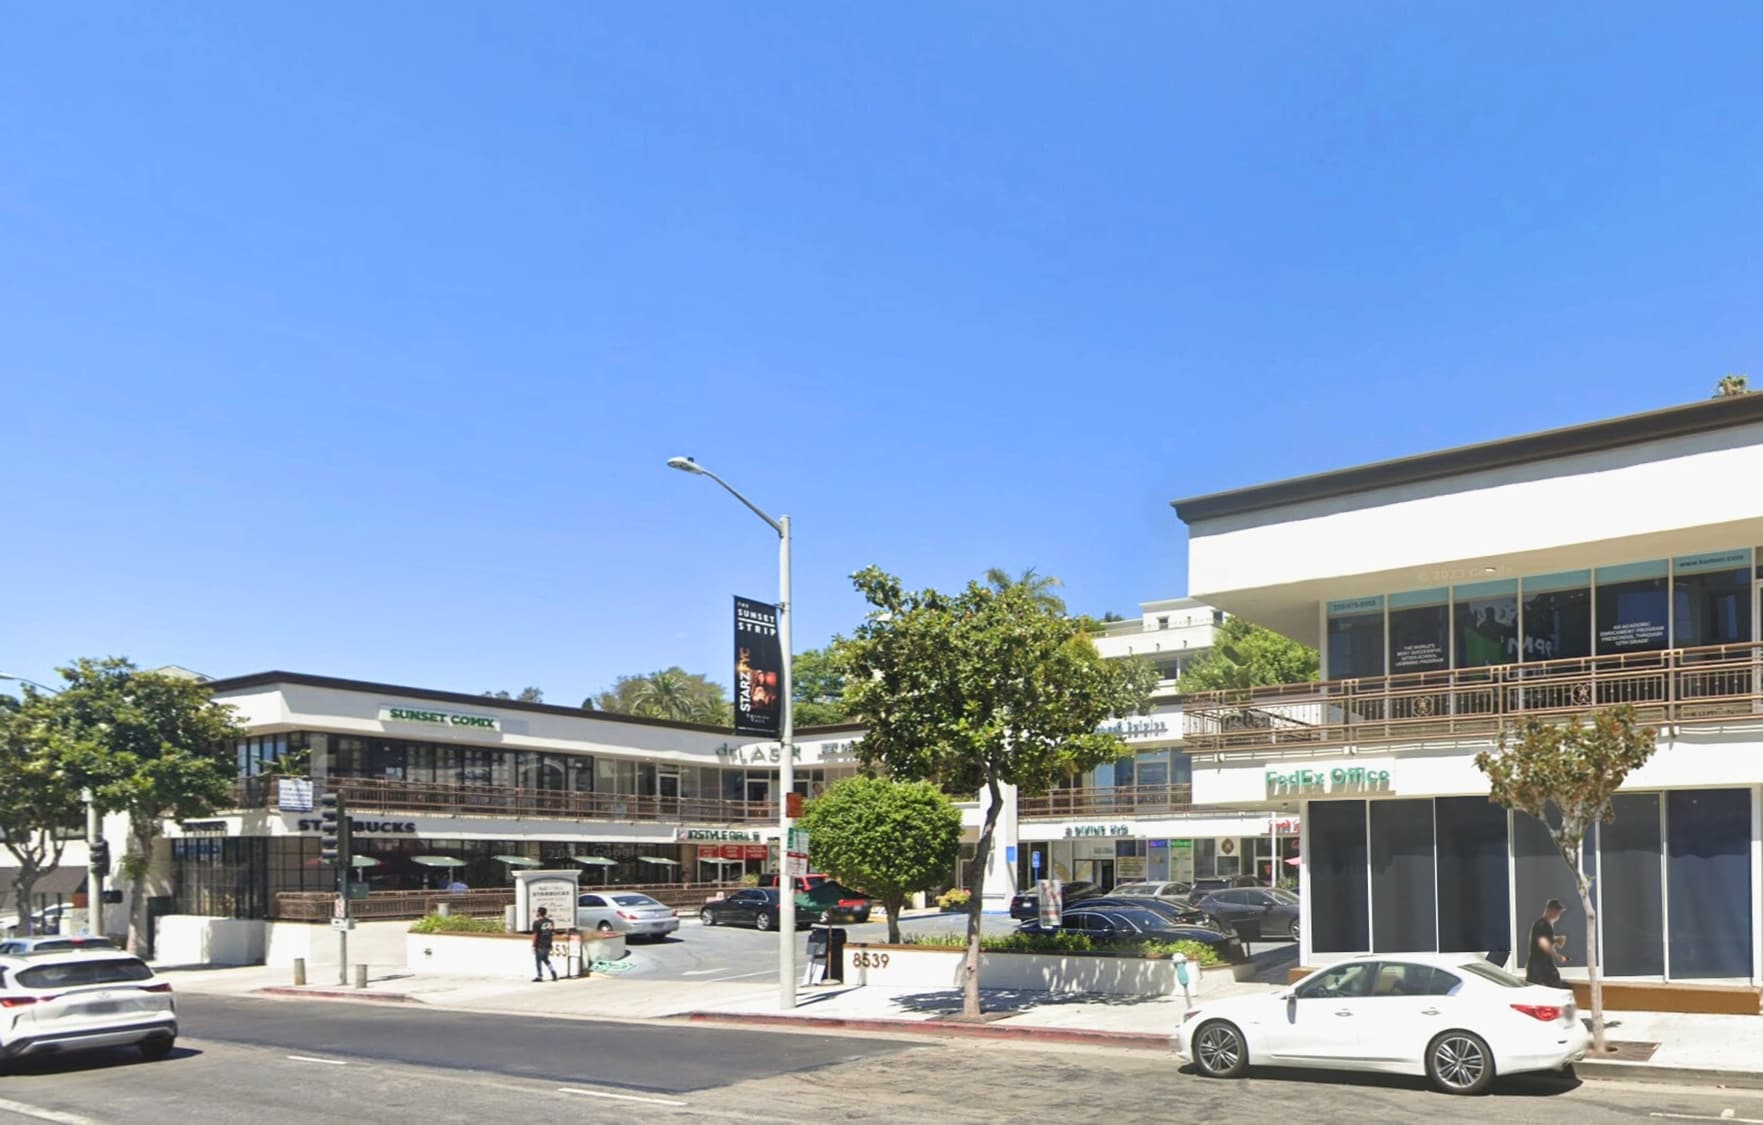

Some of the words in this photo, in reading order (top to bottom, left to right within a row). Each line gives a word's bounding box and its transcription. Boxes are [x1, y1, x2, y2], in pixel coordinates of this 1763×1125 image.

[737, 608, 775, 623] SUNSET
[737, 622, 776, 636] STRIP
[739, 672, 751, 712] STARZ
[389, 708, 448, 723] SUNSET
[450, 715, 495, 728] COMIX
[1265, 769, 1325, 788] FedEx
[1330, 767, 1390, 785] Office
[298, 818, 416, 833] STBUCKS
[853, 952, 890, 968] 8539
